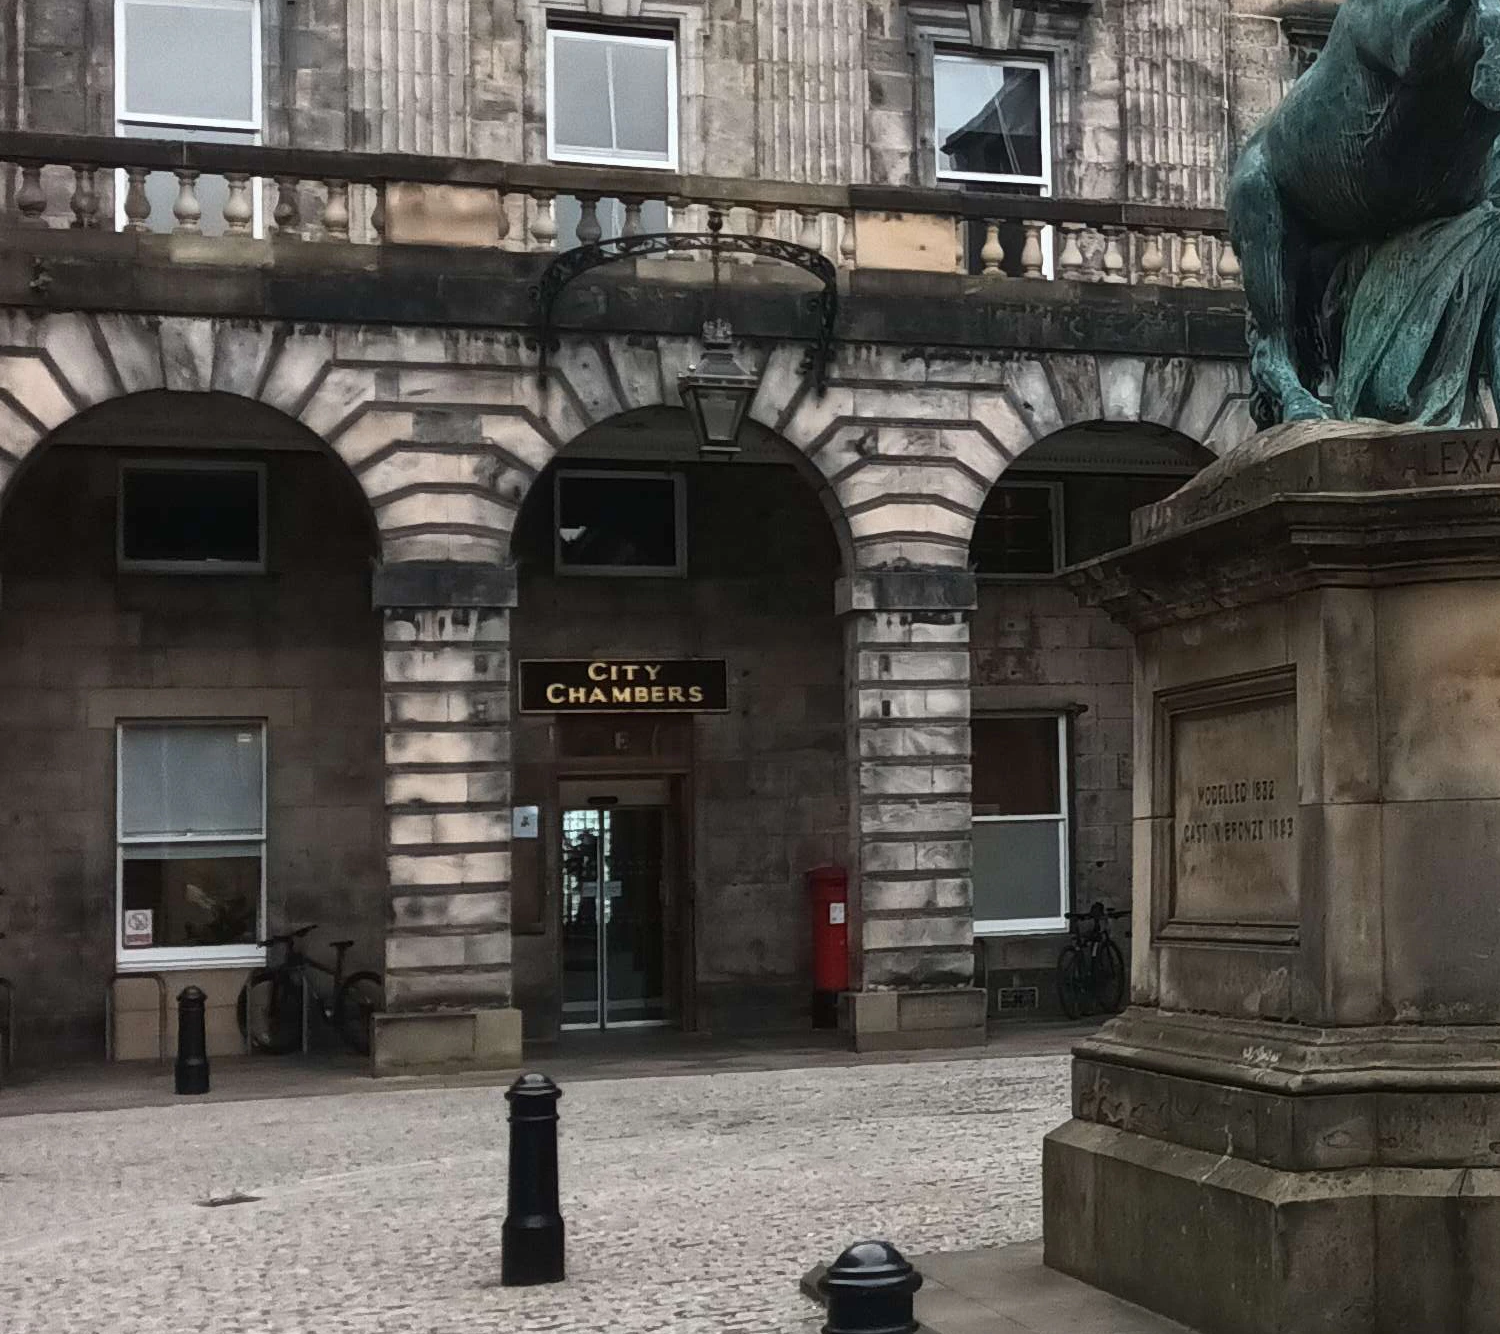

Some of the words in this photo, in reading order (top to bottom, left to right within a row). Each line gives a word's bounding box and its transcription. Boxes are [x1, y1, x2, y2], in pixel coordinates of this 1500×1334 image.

[587, 662, 661, 681] CITY
[546, 683, 704, 704] CHAMBERS
[1183, 823, 1208, 843] CAST
